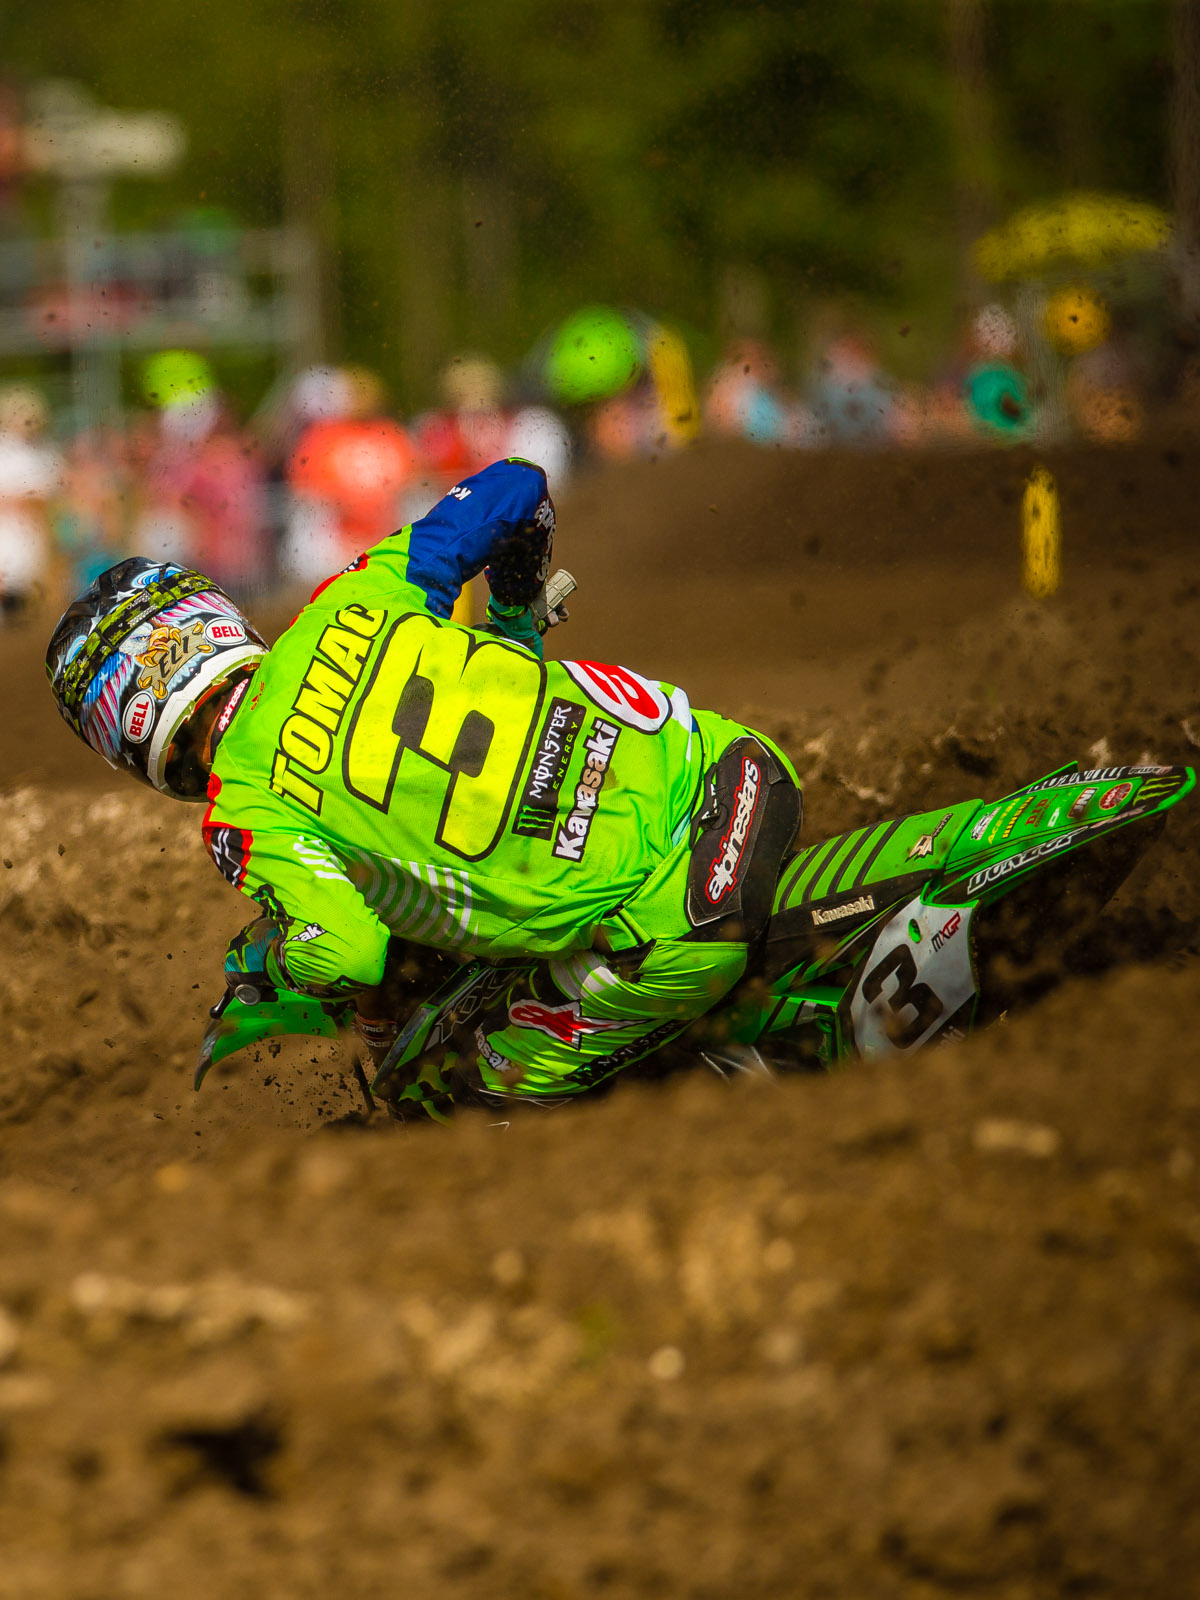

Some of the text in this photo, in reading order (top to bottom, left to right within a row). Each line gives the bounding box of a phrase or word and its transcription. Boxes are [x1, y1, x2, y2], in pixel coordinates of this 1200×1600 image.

[160, 635, 189, 678] ELI
[211, 626, 243, 638] BELL
[129, 700, 150, 737] BELL
[269, 604, 388, 816] TOMAC
[342, 612, 547, 862] 3
[529, 705, 572, 799] MONSTER
[552, 721, 578, 790] ENERGY
[555, 719, 619, 860] Kawasaki
[708, 759, 759, 901] alpinestars
[811, 895, 875, 925] Kawasaki
[931, 911, 961, 952] MXGP
[862, 943, 943, 1049] 3
